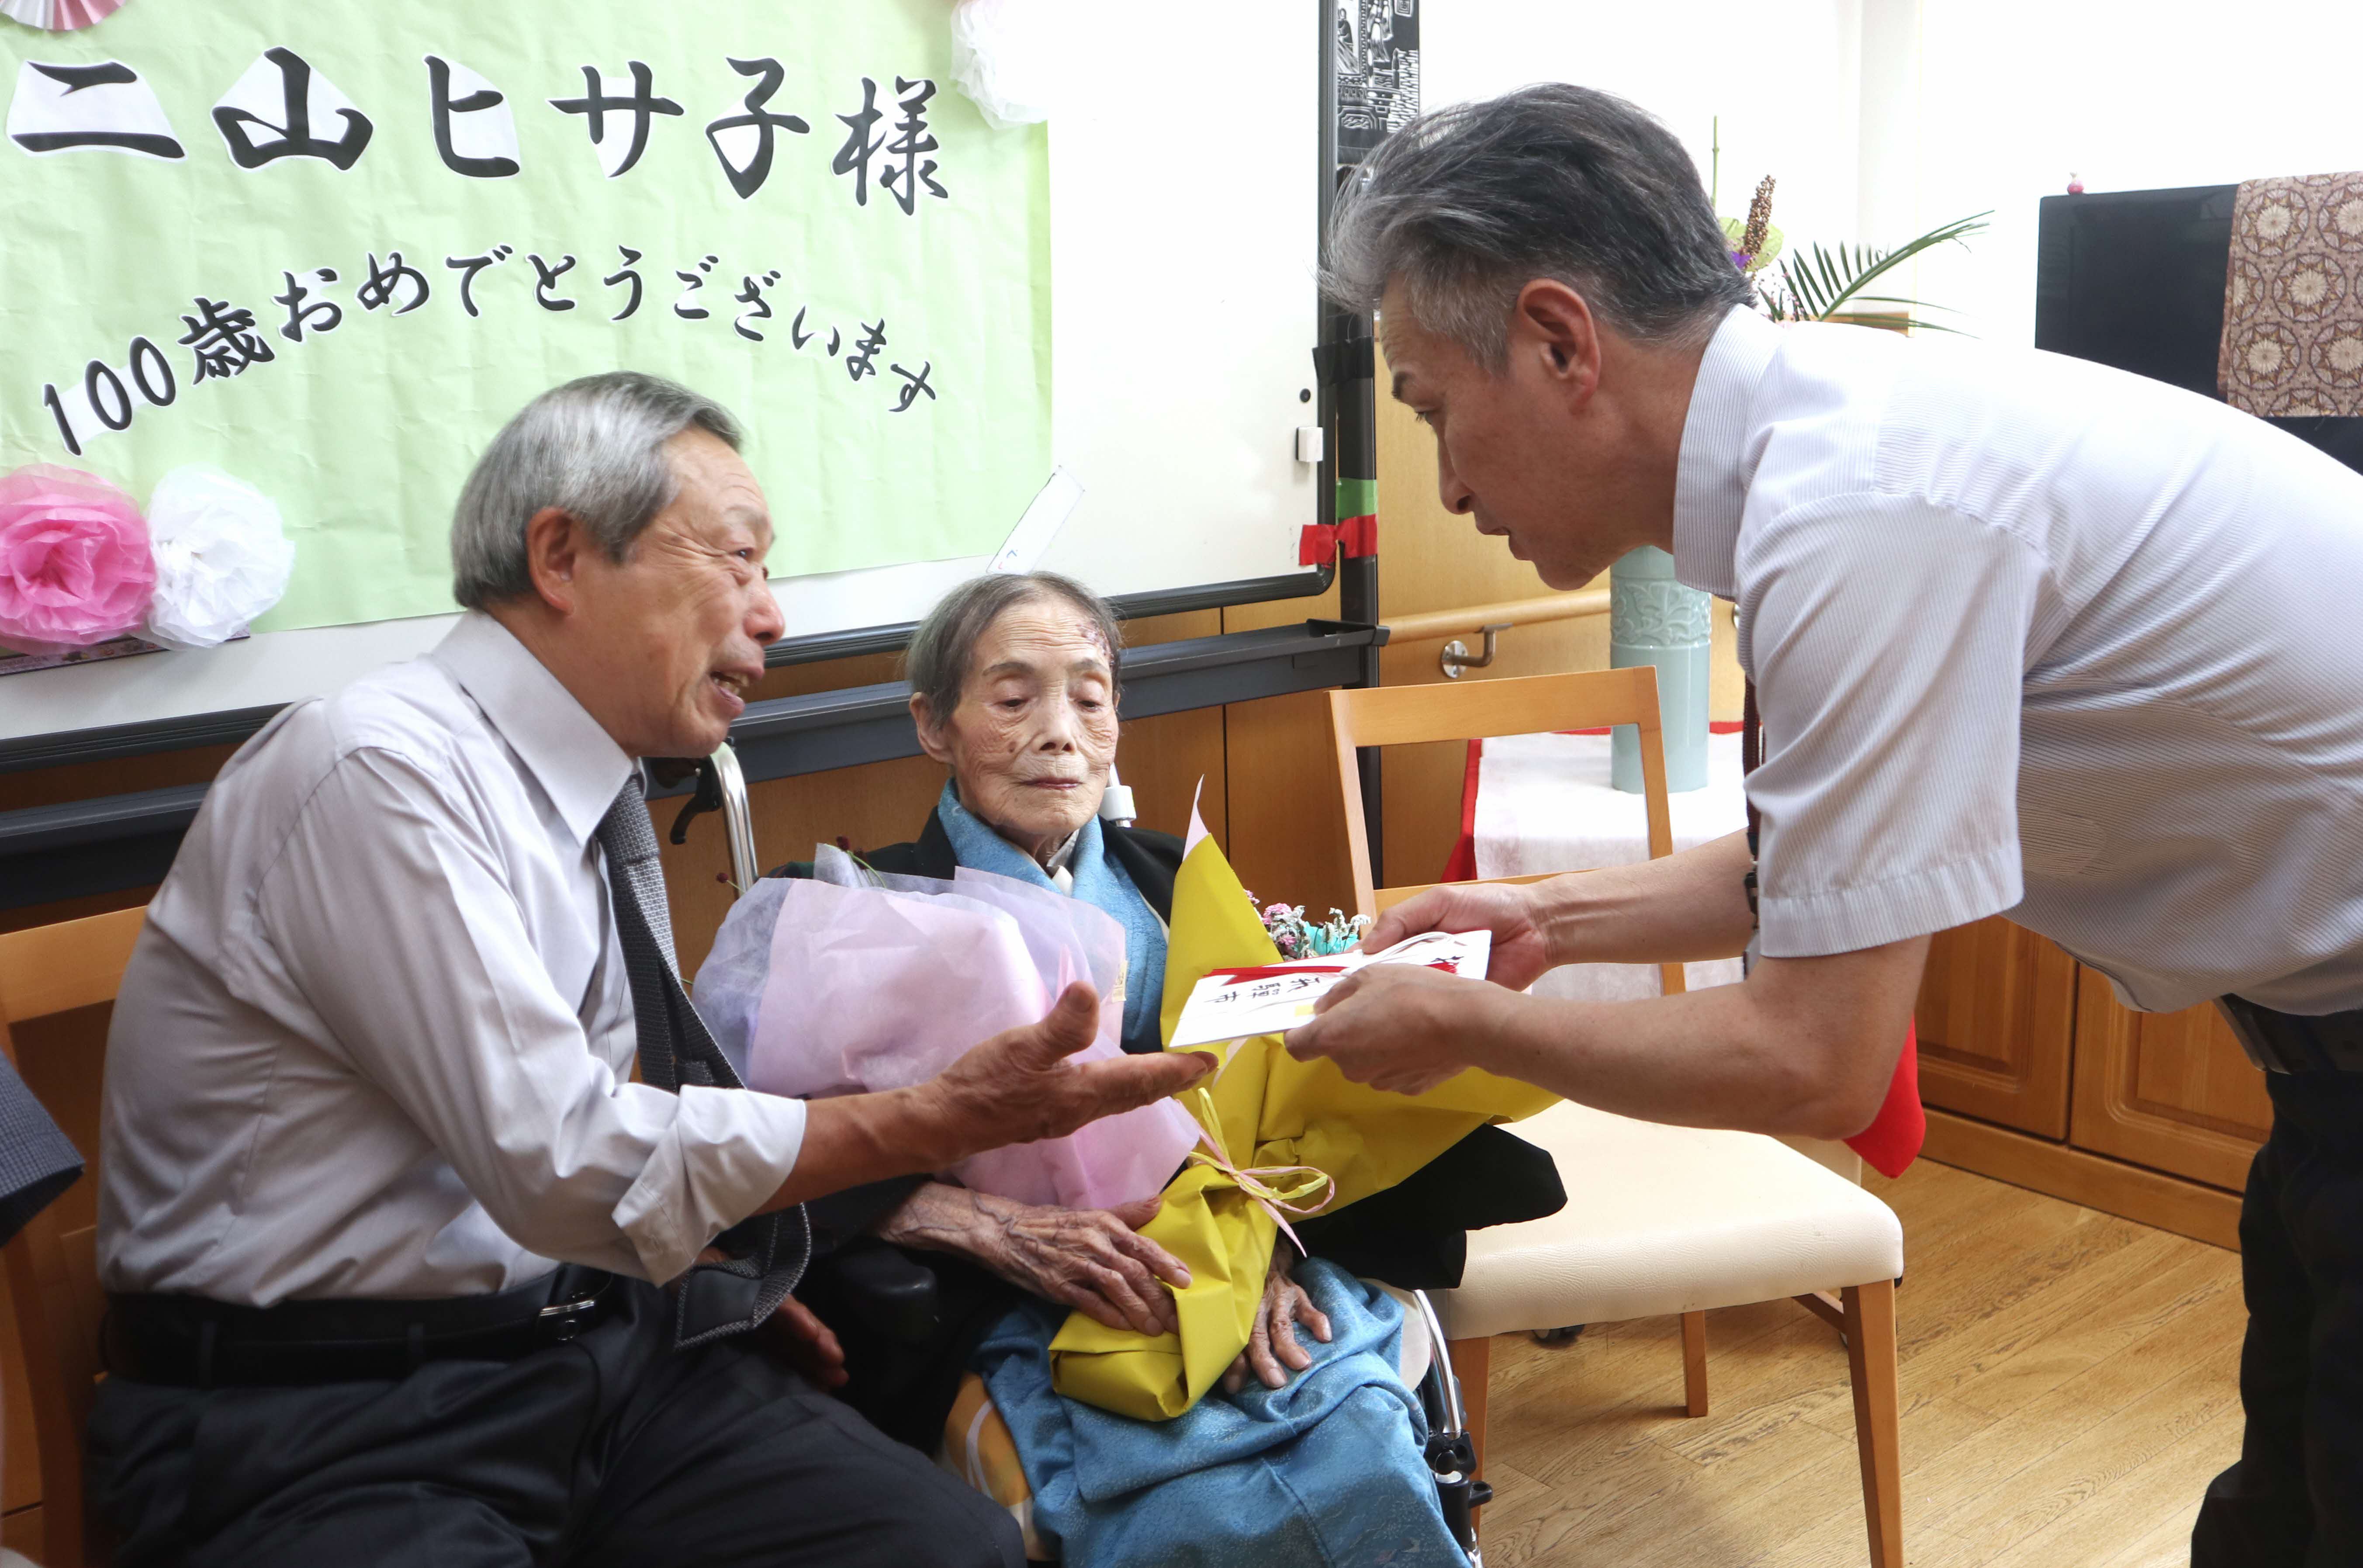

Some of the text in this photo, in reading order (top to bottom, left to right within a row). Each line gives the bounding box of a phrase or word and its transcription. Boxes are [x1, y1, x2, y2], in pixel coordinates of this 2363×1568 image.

[12, 47, 948, 216] 二山ヒサ子様
[44, 245, 936, 456] 100歳おめでとうございます
